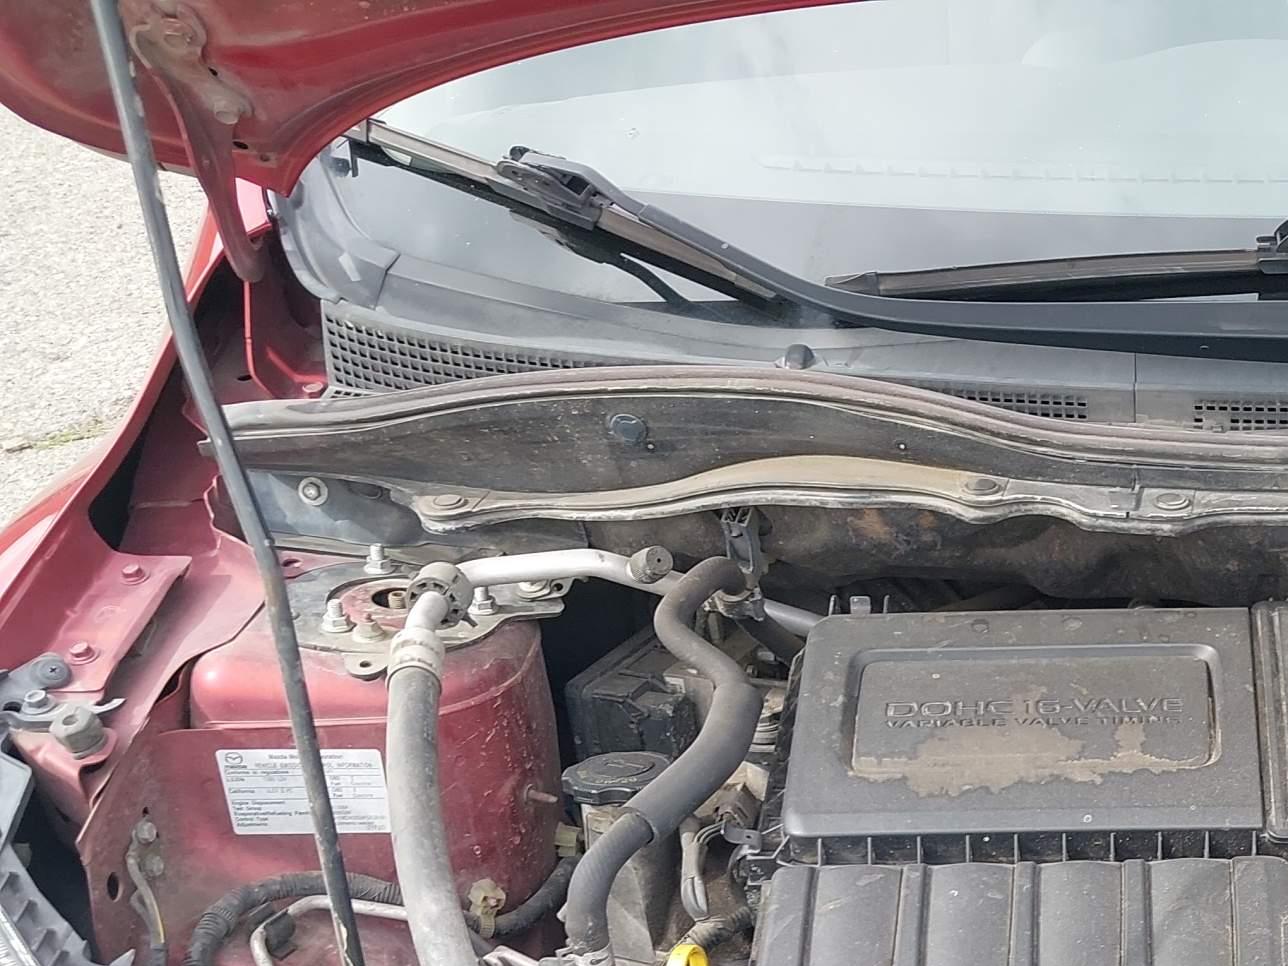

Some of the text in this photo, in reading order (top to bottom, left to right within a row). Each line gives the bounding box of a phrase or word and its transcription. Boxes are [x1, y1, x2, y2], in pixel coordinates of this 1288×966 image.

[886, 697, 1185, 718] DOHC 16-VALVE
[886, 715, 1182, 729] VARIABLE VALVE TIMING
